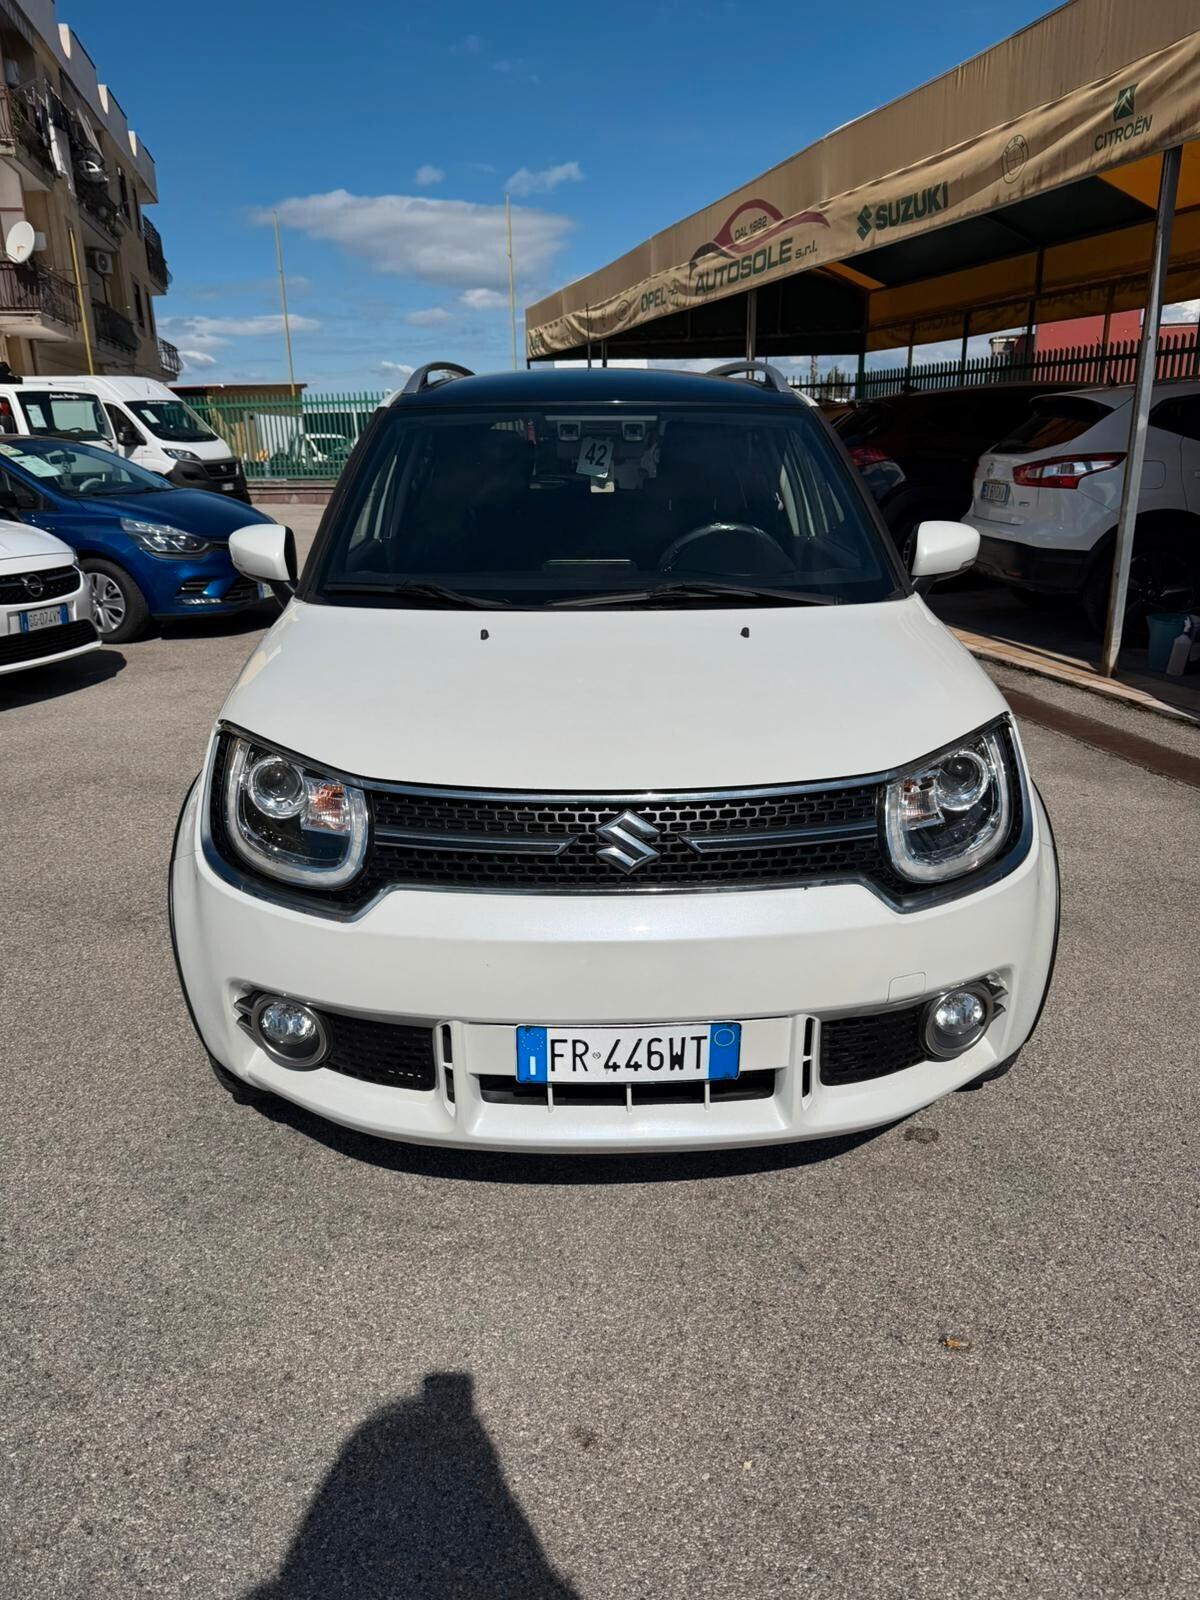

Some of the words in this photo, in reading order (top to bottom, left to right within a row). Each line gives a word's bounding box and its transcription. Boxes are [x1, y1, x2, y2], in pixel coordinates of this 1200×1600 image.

[1095, 115, 1153, 151] CITROËN
[875, 181, 949, 231] SUZUKI
[735, 225, 748, 240] DAL
[696, 237, 793, 296] AUTOSOLE
[640, 286, 668, 313] OPEL
[585, 443, 608, 467] 42
